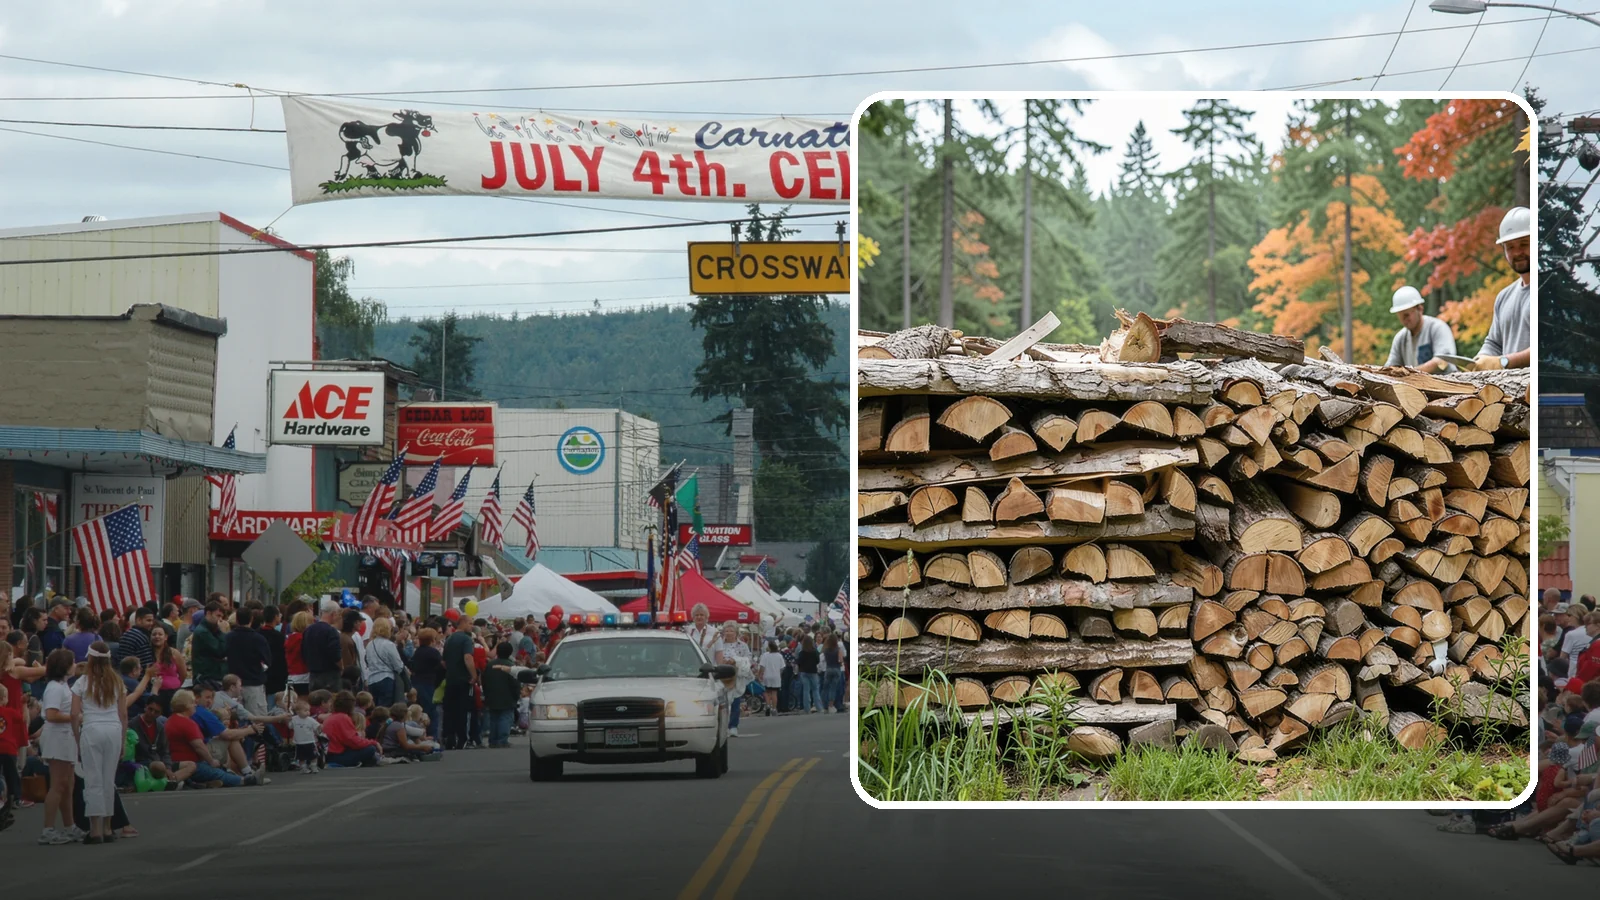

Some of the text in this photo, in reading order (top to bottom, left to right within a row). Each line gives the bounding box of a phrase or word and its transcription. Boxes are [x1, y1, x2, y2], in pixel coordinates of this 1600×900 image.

[481, 141, 605, 193] JULY
[632, 149, 746, 198] 4th.
[696, 254, 850, 280] CROSSWA
[282, 379, 374, 420] ACE
[405, 409, 453, 421] CEDAR
[283, 421, 371, 436] Hardware
[416, 428, 478, 447] Coca-Cola
[353, 467, 384, 478] Simpl
[83, 485, 155, 495] St. Vincent de Paul
[688, 526, 741, 535] CRNATION
[699, 535, 730, 543] GLASS
